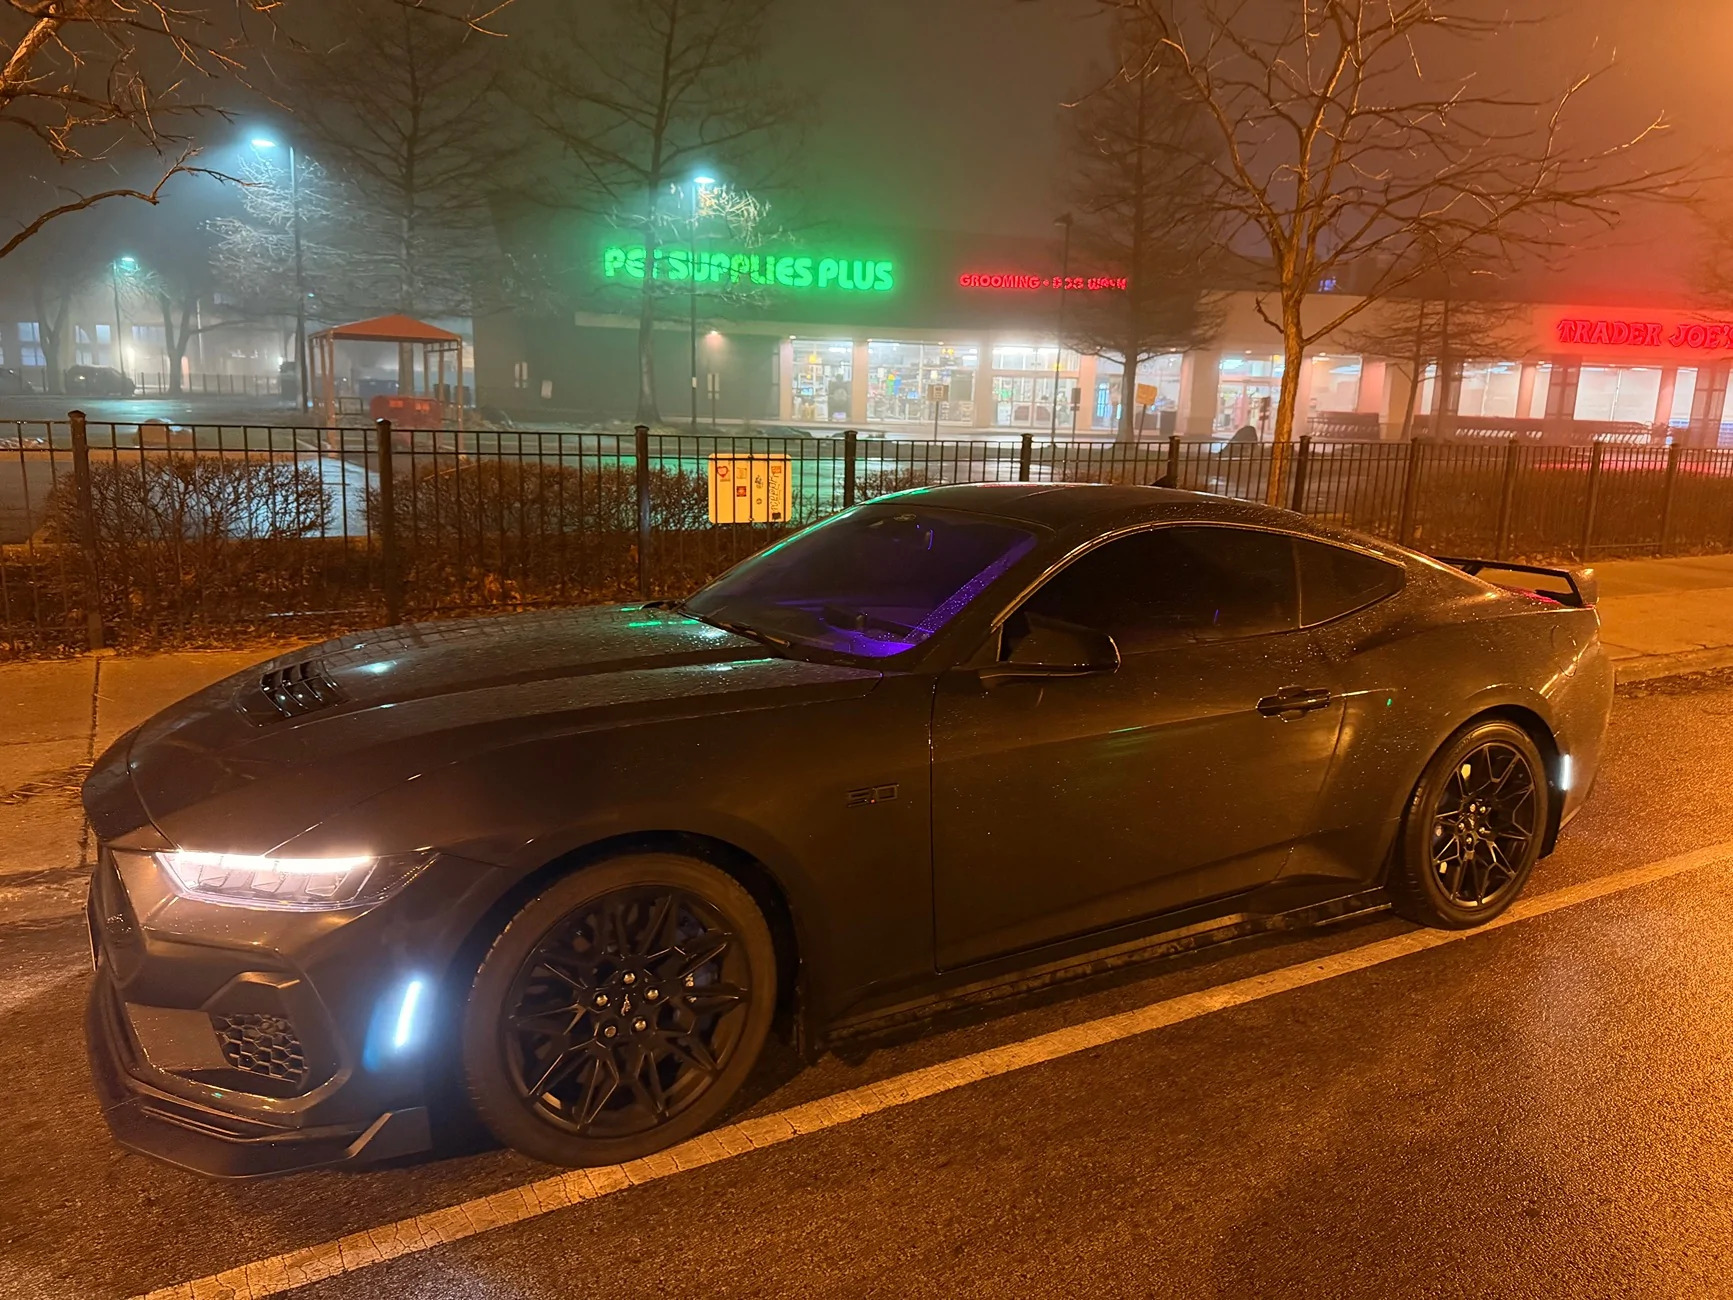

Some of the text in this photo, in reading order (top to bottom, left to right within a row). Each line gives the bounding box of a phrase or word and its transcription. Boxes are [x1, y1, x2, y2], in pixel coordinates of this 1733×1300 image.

[667, 250, 813, 287] SUPPLIES
[818, 257, 894, 291] PLUS
[959, 273, 1040, 289] GROOMING
[1557, 319, 1662, 346] TRADER
